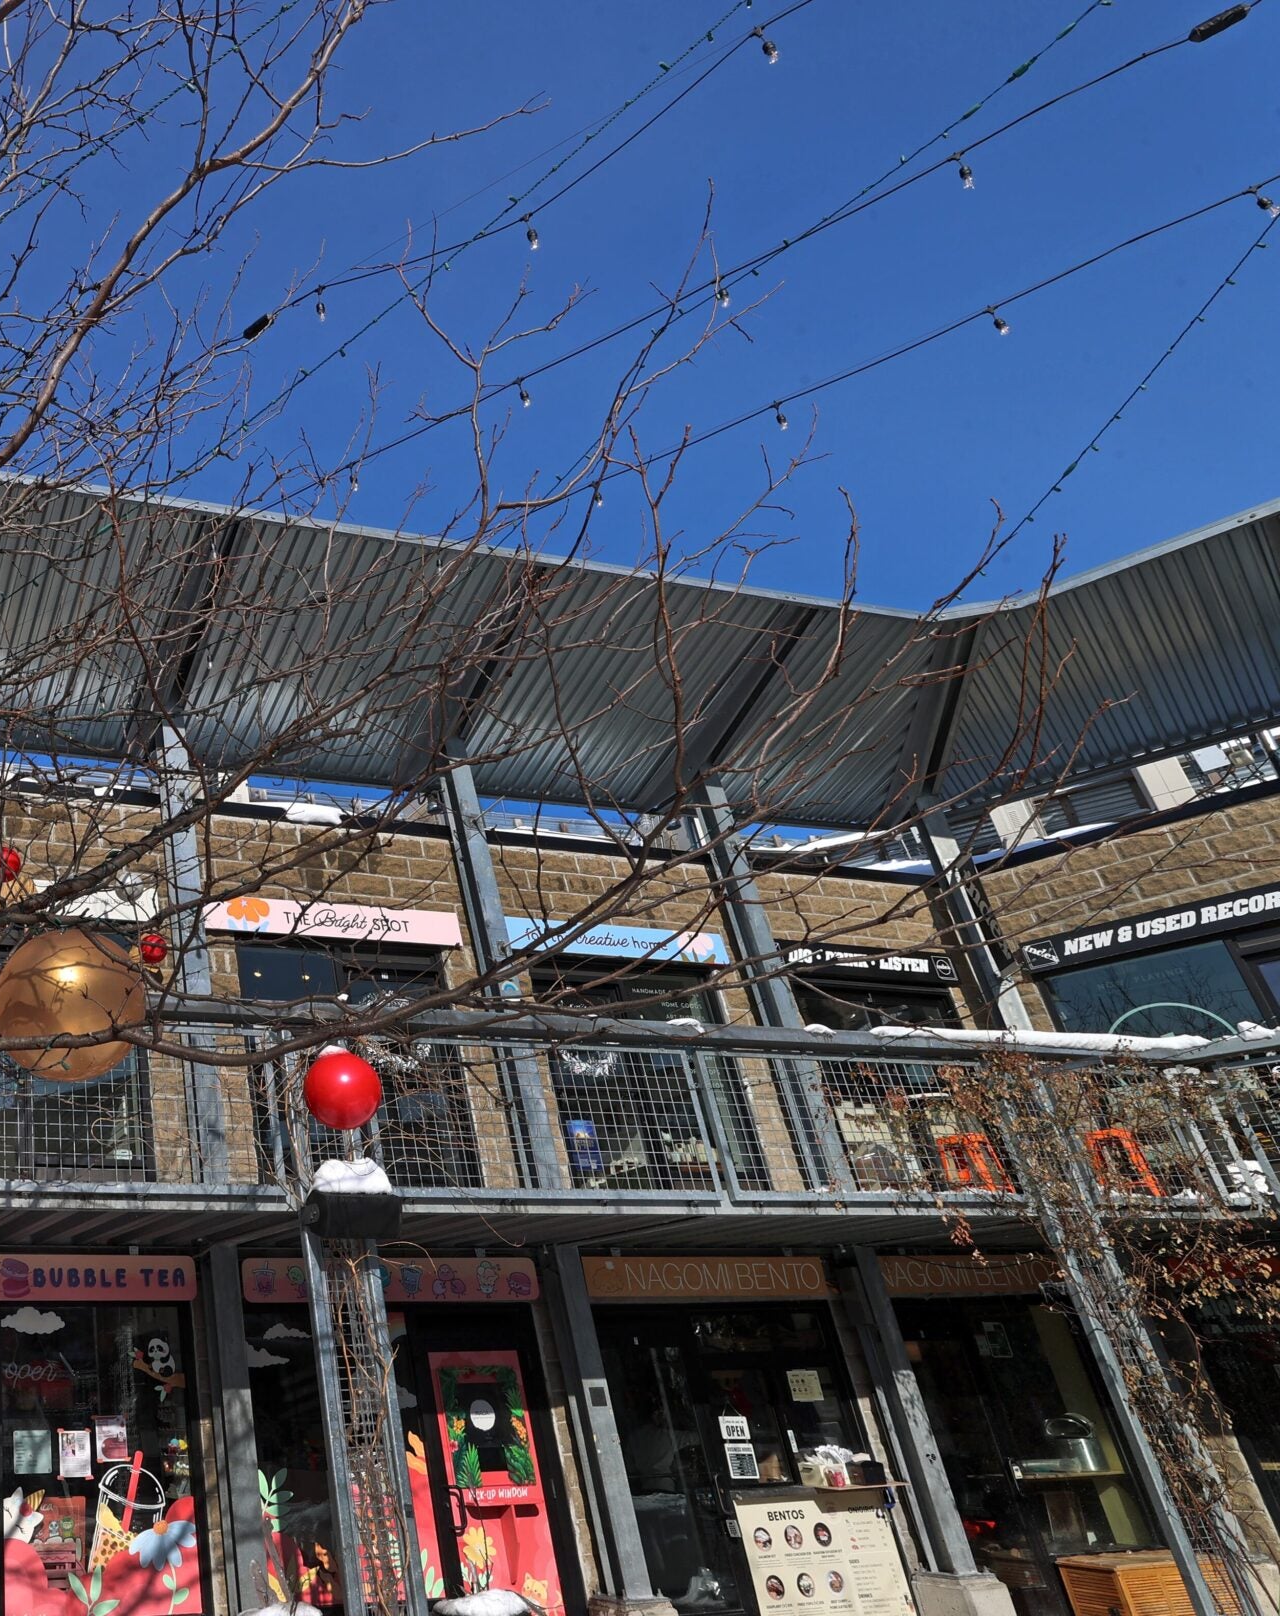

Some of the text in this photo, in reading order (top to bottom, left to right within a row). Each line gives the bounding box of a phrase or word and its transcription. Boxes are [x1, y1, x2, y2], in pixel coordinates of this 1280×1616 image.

[283, 909, 410, 933] THE Bright SHOT
[576, 931, 630, 948] creative
[1063, 930, 1115, 956] NEW
[1118, 925, 1133, 943] &
[1136, 911, 1196, 939] USED
[879, 956, 930, 974] LISTEN
[31, 1267, 128, 1288] BUBBLE
[140, 1267, 187, 1288] TEA
[624, 1263, 820, 1290] NAGOMI BENTO
[972, 1260, 1051, 1287] BENTO
[4, 1361, 57, 1388] open
[725, 1425, 746, 1437] OPEN
[498, 1486, 528, 1499] WINDOW
[767, 1510, 805, 1521] BENTOS
